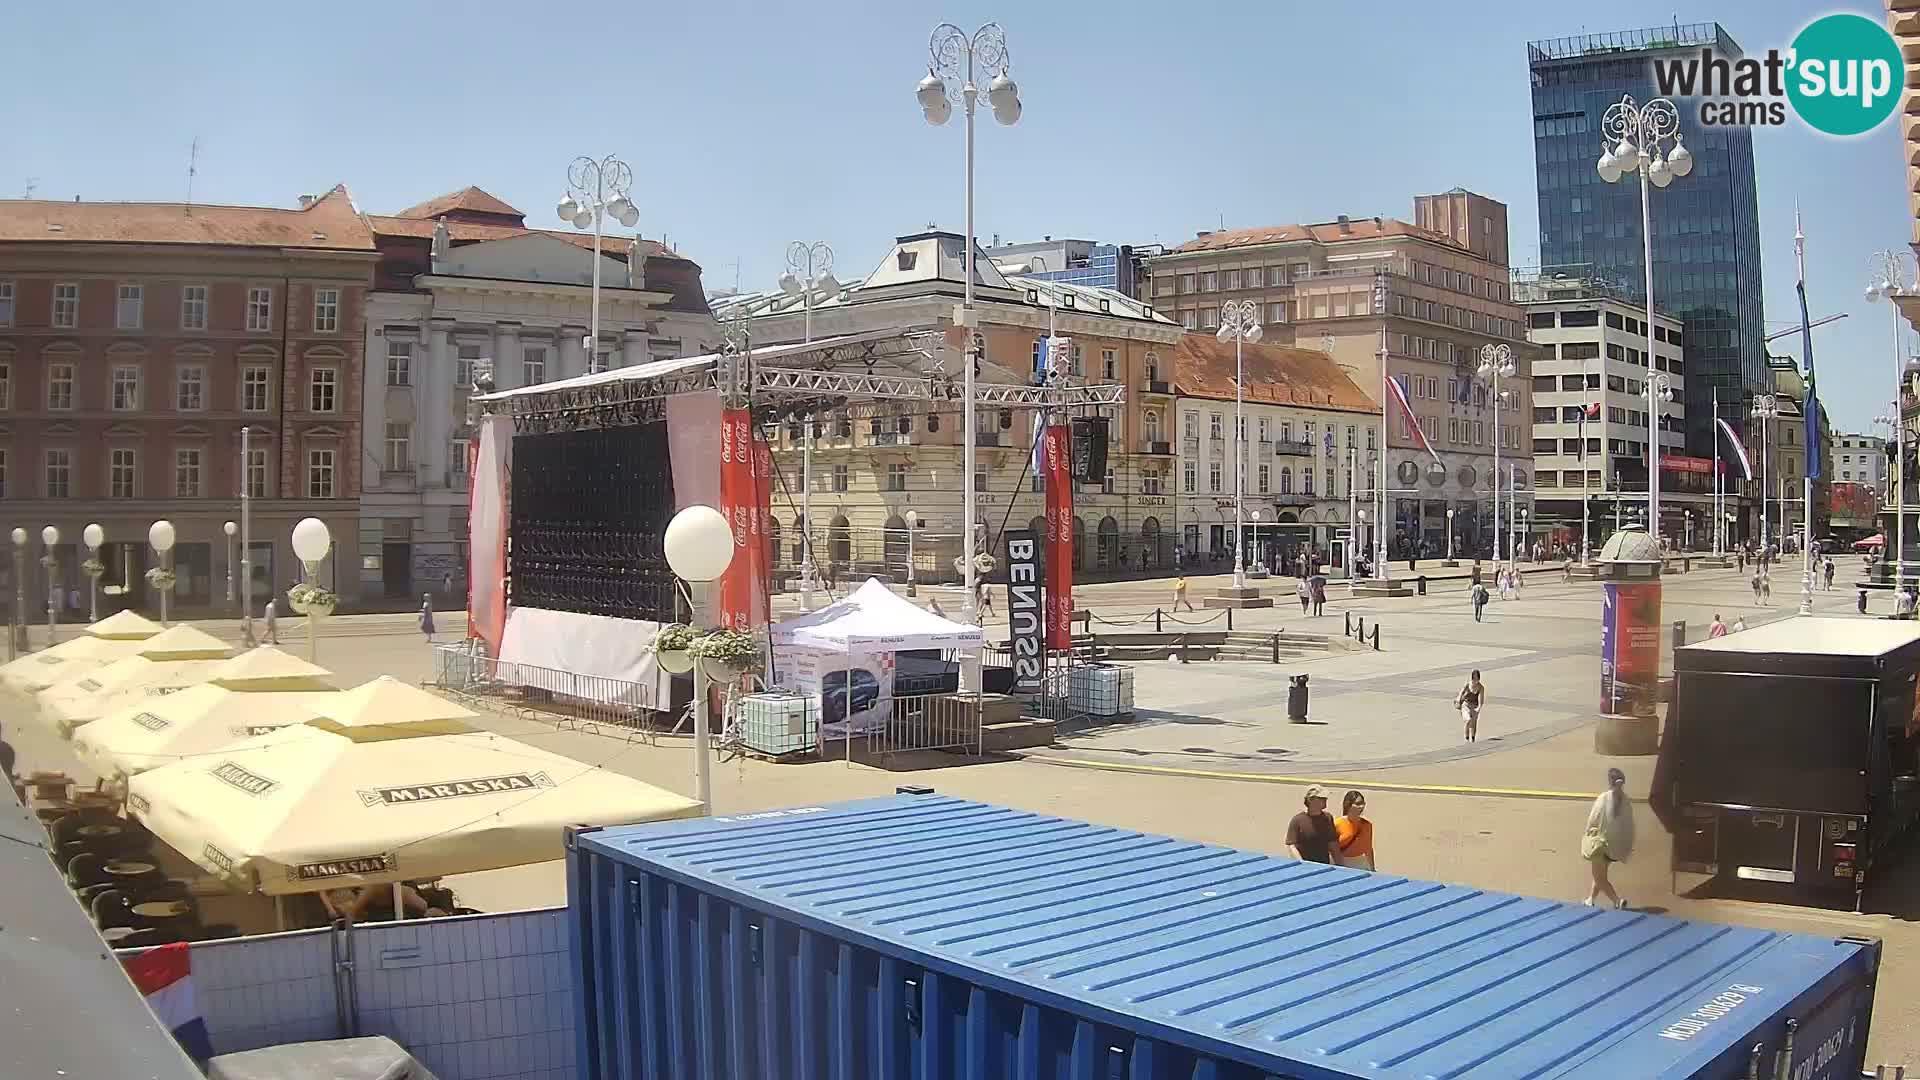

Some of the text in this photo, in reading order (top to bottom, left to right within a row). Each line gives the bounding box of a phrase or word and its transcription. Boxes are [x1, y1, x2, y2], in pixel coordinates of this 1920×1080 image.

[1137, 496, 1167, 506] SINGER
[390, 777, 528, 803] MARASKA
[303, 859, 382, 877] MARASKA
[1693, 991, 1748, 1021] 300629
